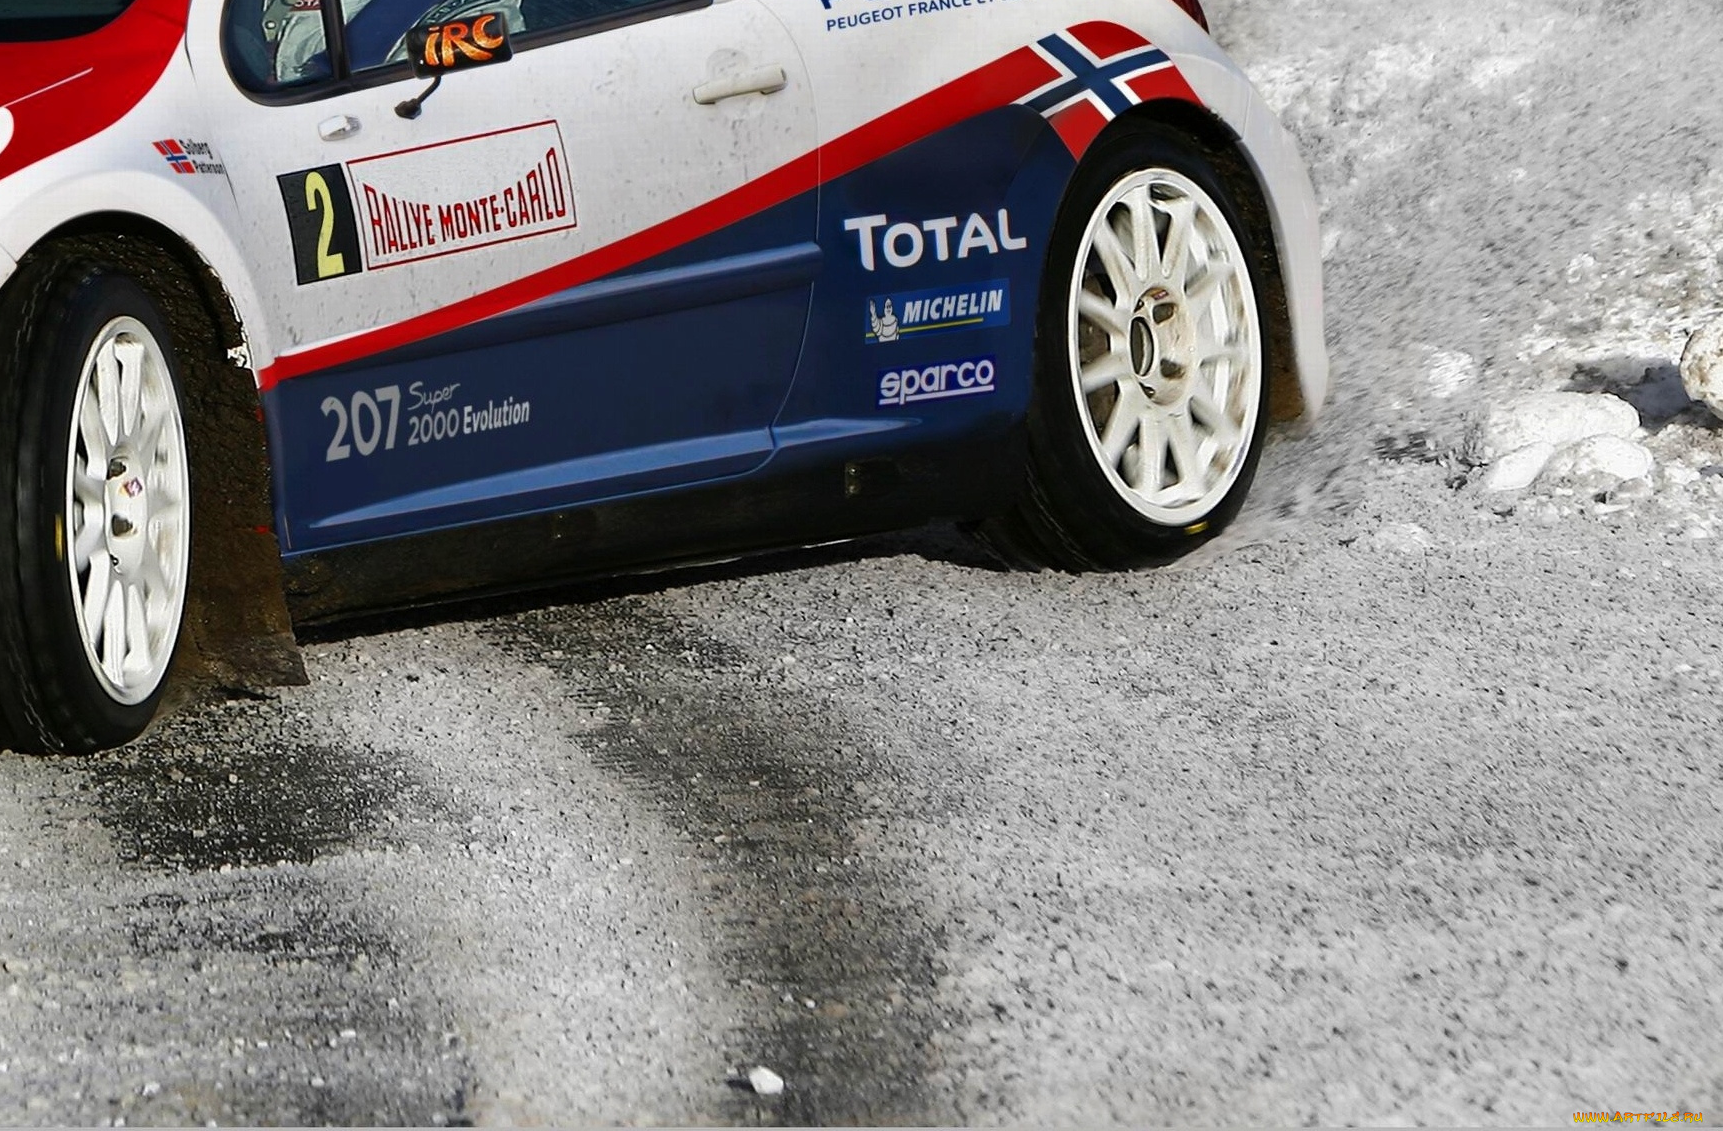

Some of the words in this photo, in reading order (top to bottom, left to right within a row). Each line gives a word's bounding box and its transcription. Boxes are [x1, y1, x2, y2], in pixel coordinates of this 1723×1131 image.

[826, 5, 904, 32] PEUGEOT
[304, 171, 345, 279] 2
[362, 182, 436, 257] RALLYE
[843, 207, 1027, 272] TOTAL
[902, 288, 1004, 325] MICHELIN
[407, 380, 461, 414] Super
[879, 357, 995, 406] sparco
[320, 384, 401, 462] 207
[407, 408, 460, 447] 2000
[463, 395, 530, 436] Evolution
